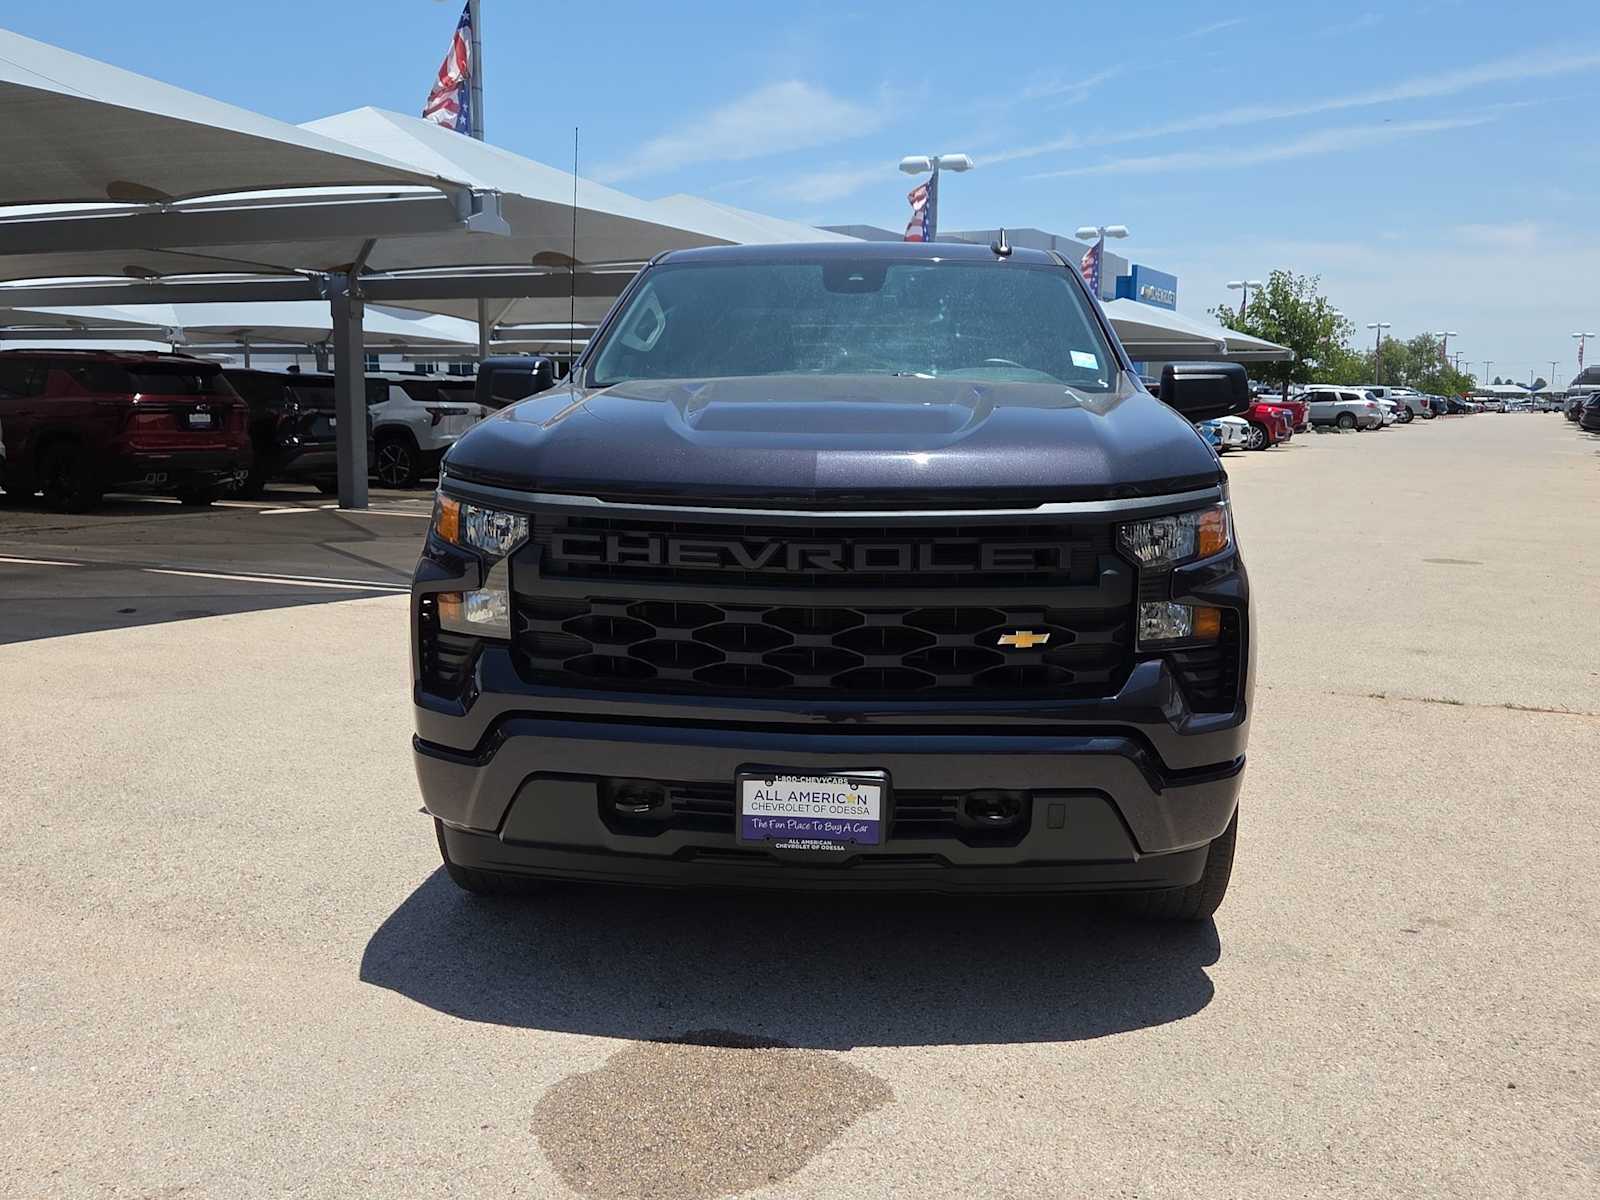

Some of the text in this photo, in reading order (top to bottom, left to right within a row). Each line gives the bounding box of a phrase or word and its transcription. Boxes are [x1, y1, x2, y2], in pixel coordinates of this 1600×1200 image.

[551, 532, 1092, 574] CHEVROLET
[754, 790, 867, 805] ALL AMERICN
[751, 802, 870, 815] CHEVROLET OF ODESSA
[751, 818, 768, 829] The
[787, 819, 810, 831] Place
[812, 820, 823, 831] To
[824, 821, 842, 834] Buy
[843, 822, 852, 832] A
[853, 822, 868, 833] Car
